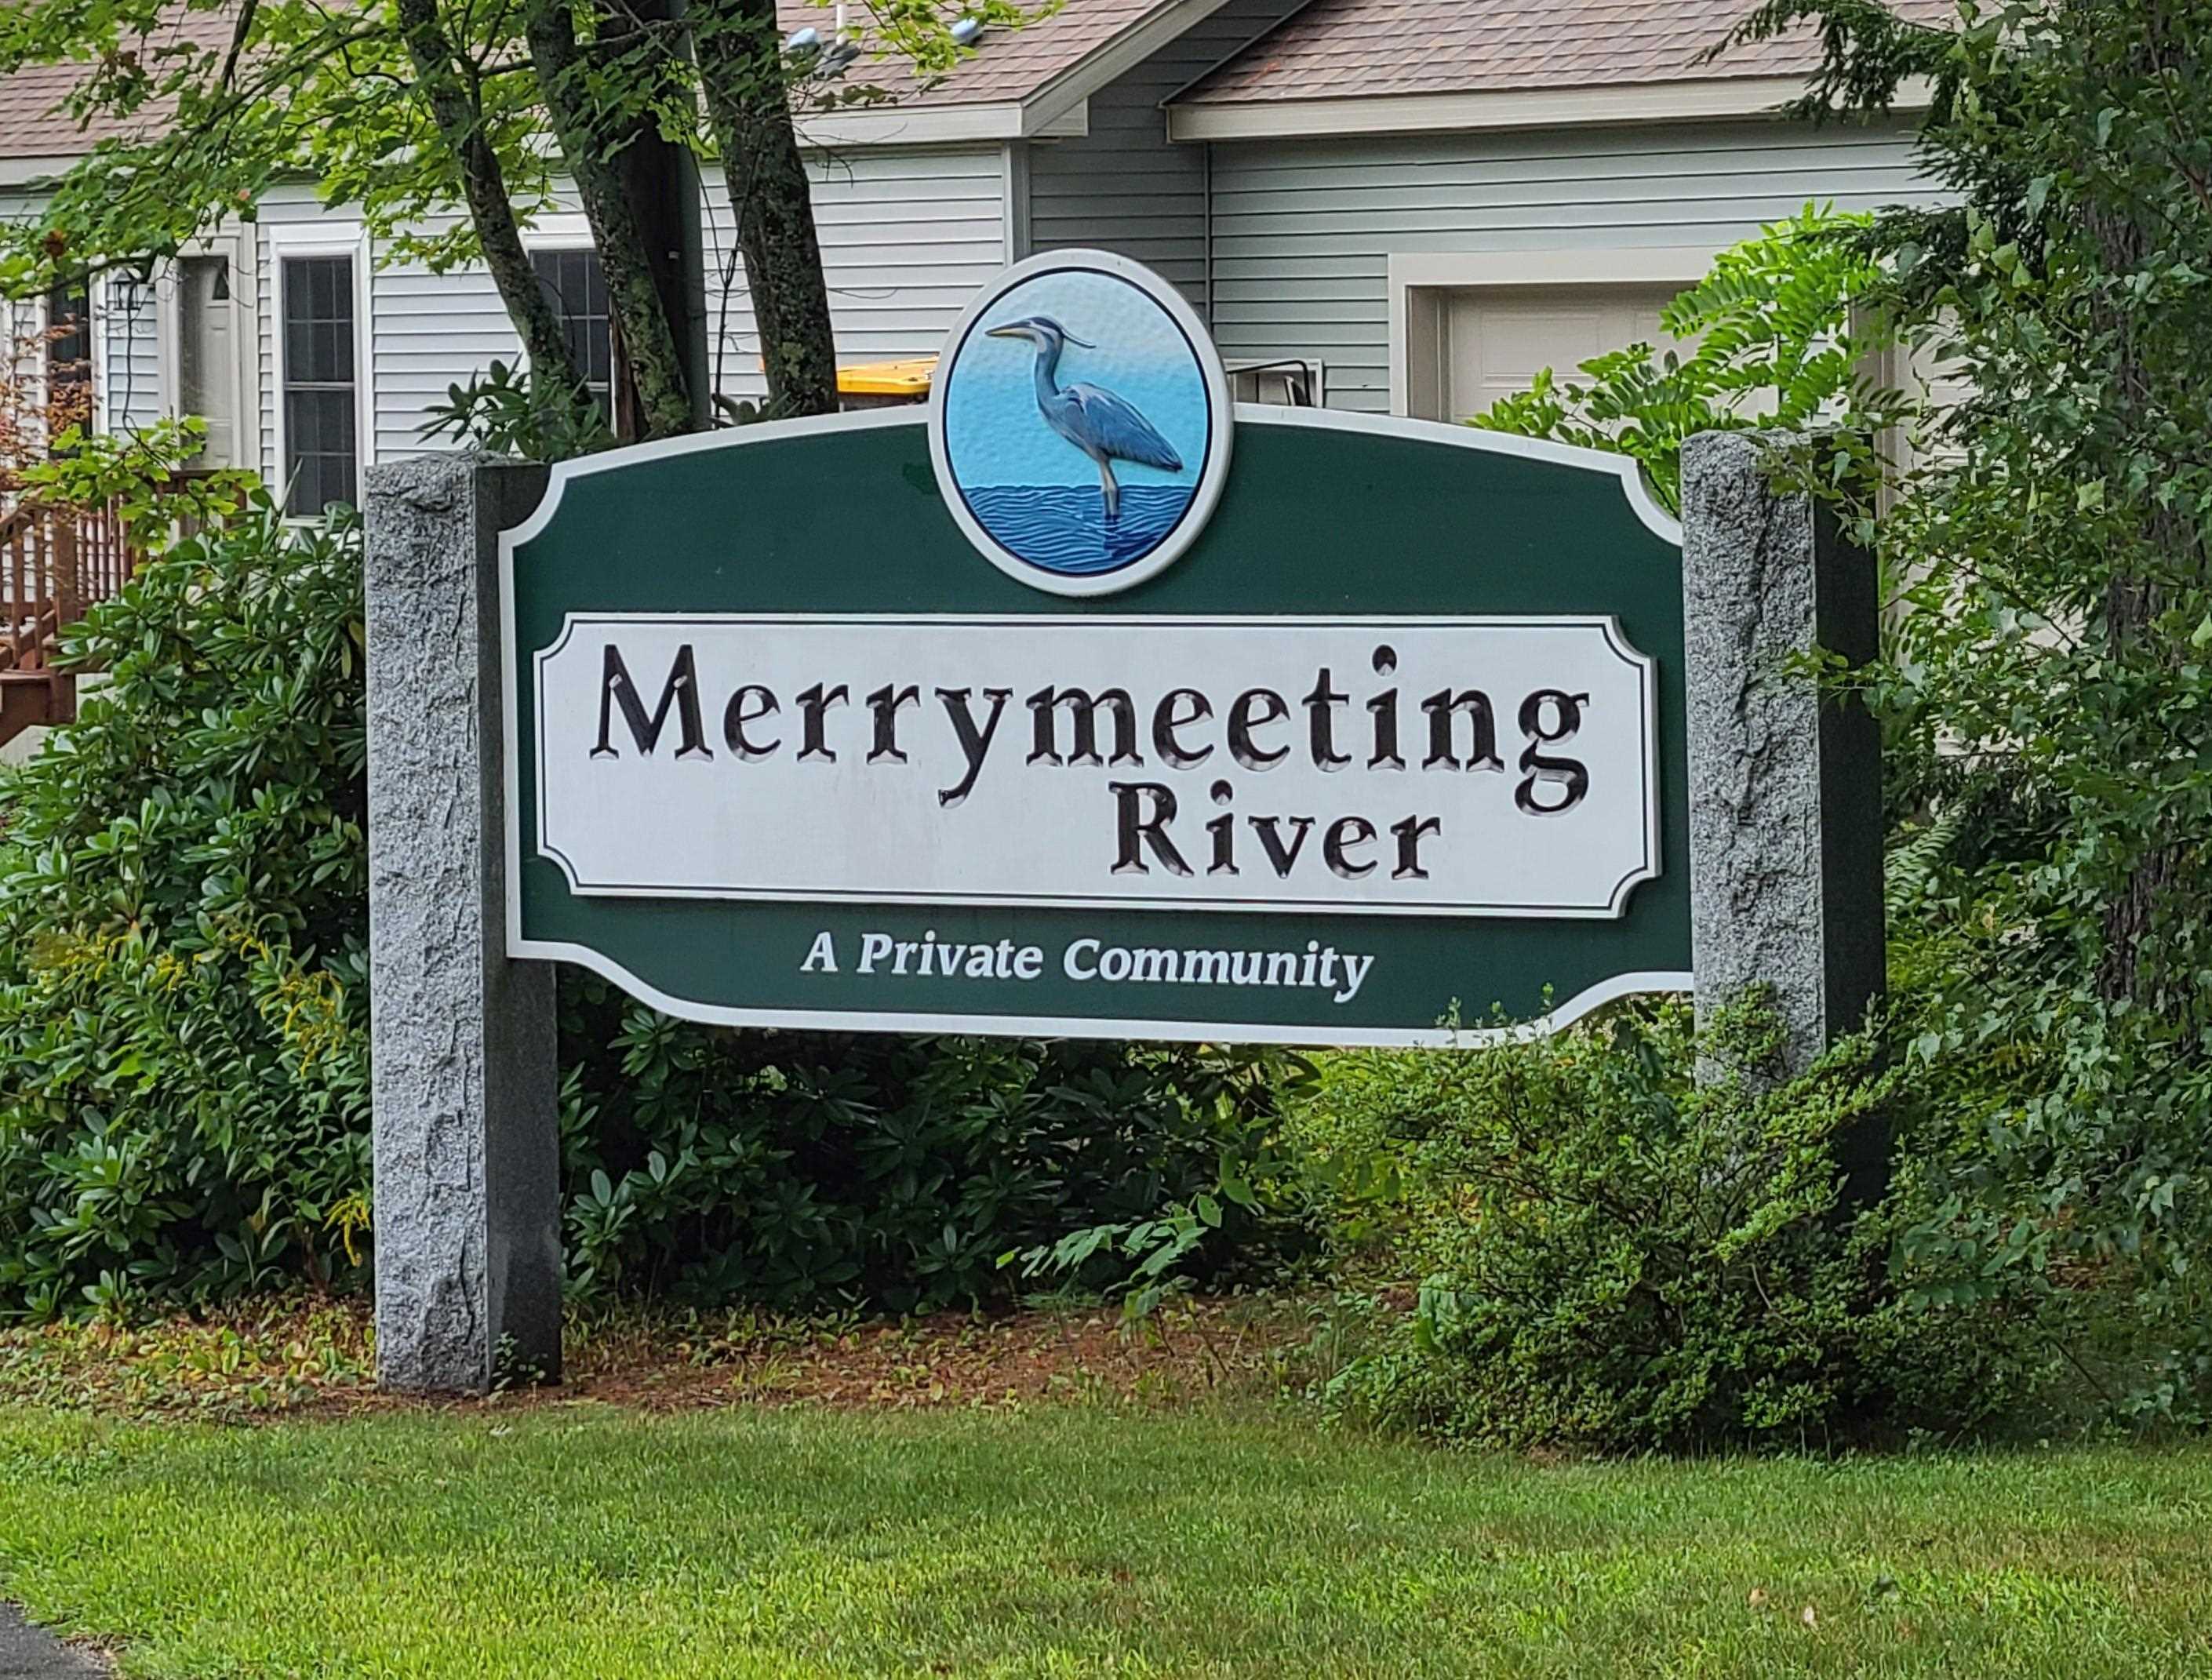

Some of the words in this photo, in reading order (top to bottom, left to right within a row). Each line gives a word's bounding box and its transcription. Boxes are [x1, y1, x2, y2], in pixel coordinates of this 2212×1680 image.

[589, 643, 1590, 816] Merrymeeting
[1108, 779, 1442, 881] River
[799, 931, 839, 973] A
[856, 929, 1044, 980] Private
[1064, 938, 1375, 1003] Community
